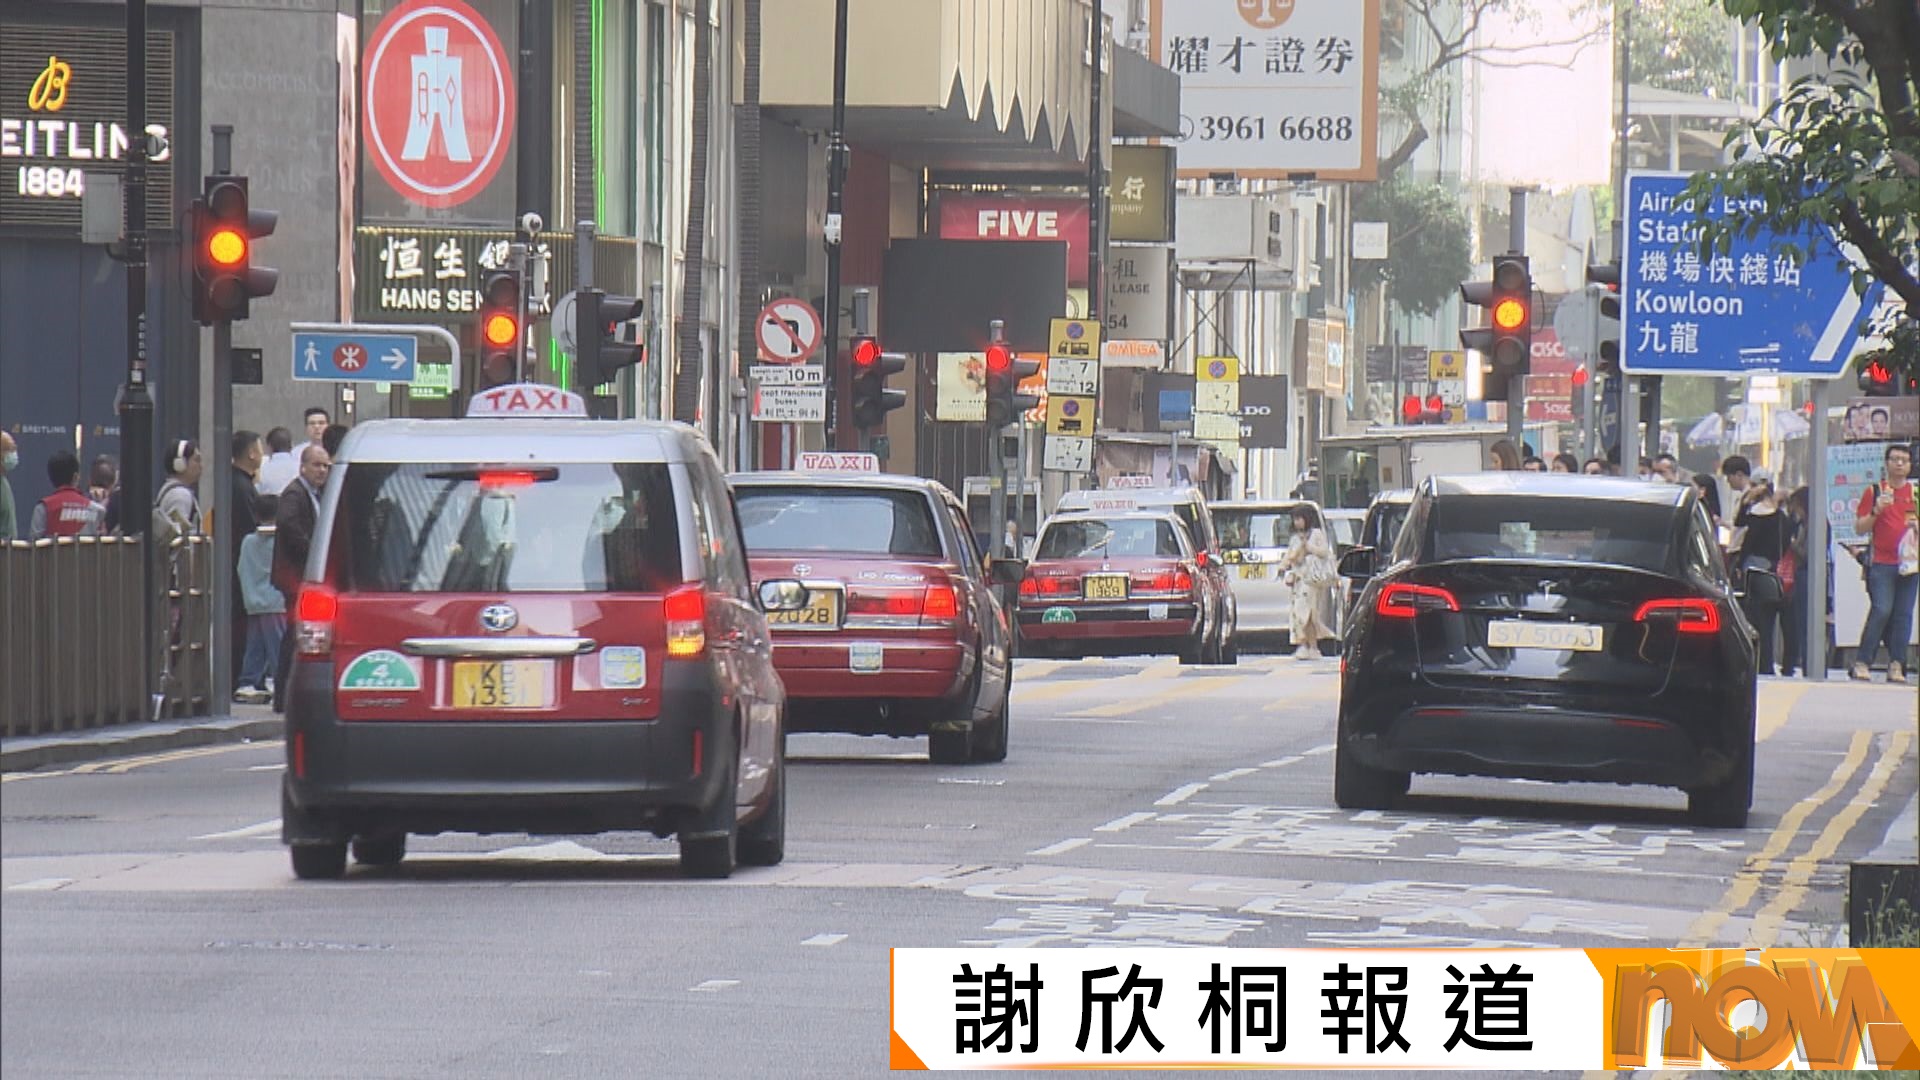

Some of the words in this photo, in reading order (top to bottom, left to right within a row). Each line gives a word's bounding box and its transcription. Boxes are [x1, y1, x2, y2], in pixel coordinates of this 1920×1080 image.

[1168, 36, 1354, 74] 耀才證券
[1200, 116, 1265, 141] 3961
[1280, 116, 1353, 141] 6688
[18, 165, 84, 197] 1884
[1111, 203, 1144, 215] mpany
[978, 209, 1058, 237] FIVE
[1638, 250, 1801, 287] 機場快綫站
[381, 287, 441, 311] HANG
[446, 288, 484, 312] SEN
[1112, 283, 1150, 294] LEASE
[1635, 289, 1743, 316] Kowloon
[1637, 320, 1699, 354] 九龍
[787, 367, 805, 382] 10
[807, 371, 821, 382] m
[1079, 361, 1089, 374] 7
[780, 389, 823, 397] franchised
[1078, 381, 1095, 394] 12
[485, 388, 570, 411] TAXI
[803, 454, 872, 471] TAXI
[372, 664, 389, 678] 4
